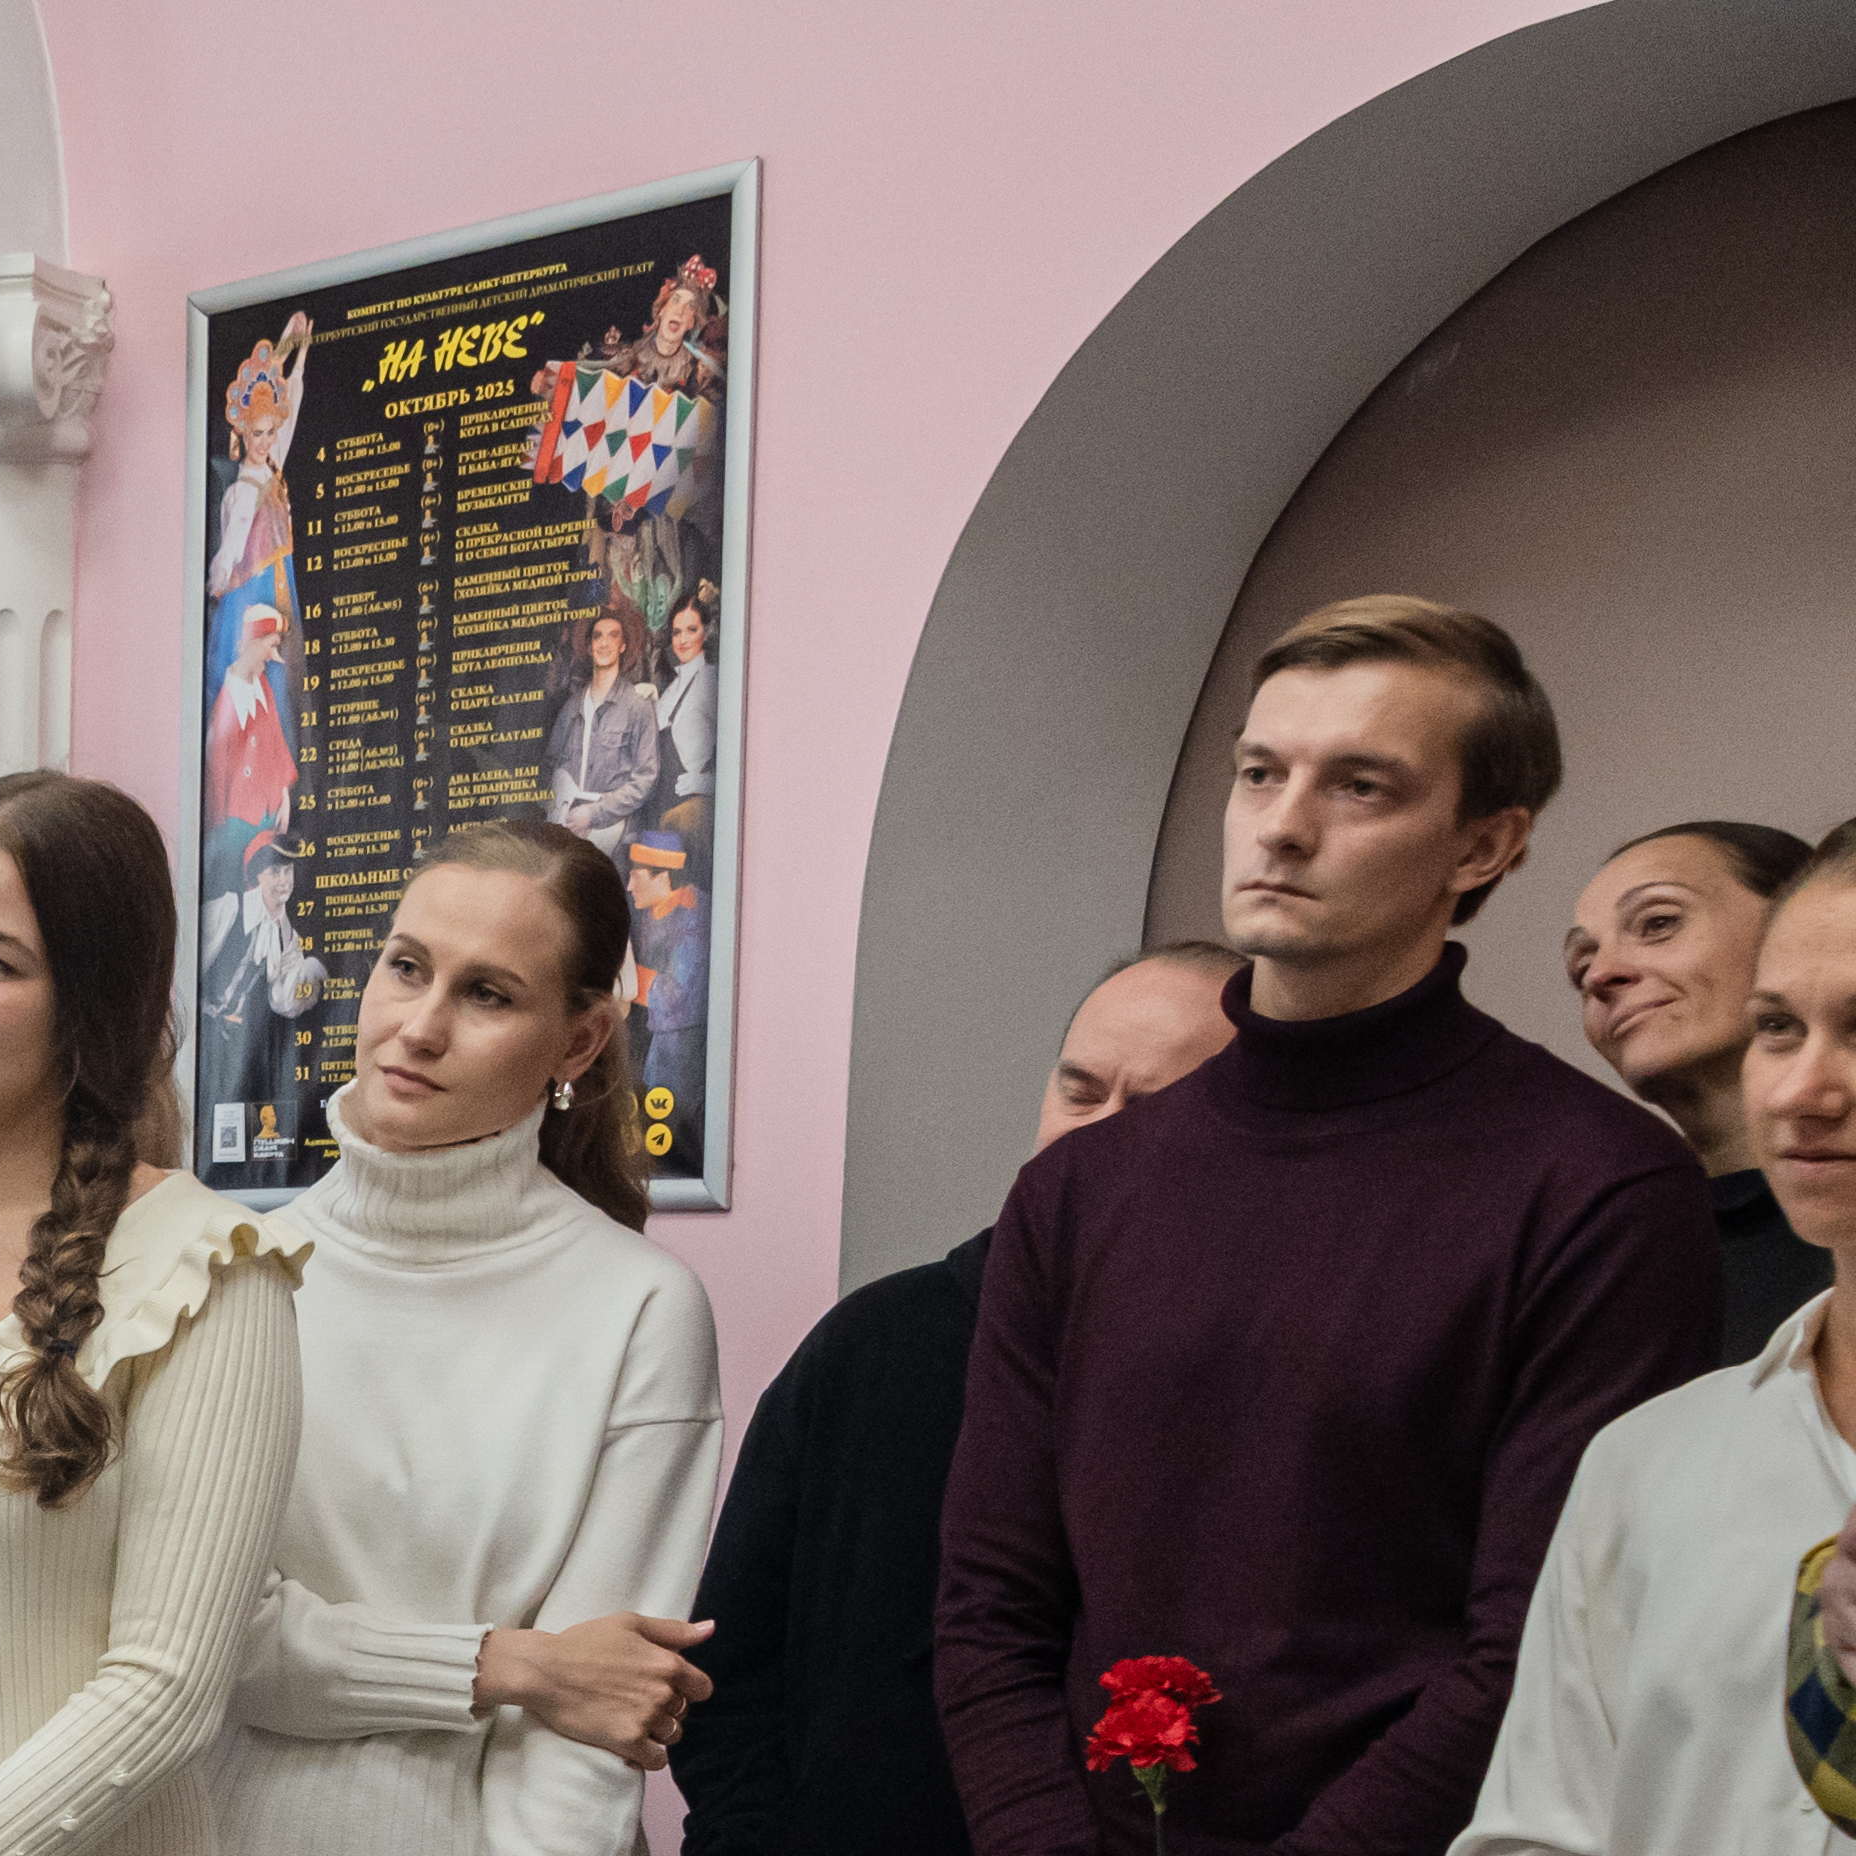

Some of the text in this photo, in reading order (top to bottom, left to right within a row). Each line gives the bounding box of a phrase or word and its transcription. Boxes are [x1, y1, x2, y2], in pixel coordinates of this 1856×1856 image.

[347, 261, 567, 320] КОМИТЕТ ПО КУЛЬТУРЕ САНКТ-ПЕТЕРБУРГА
[480, 287, 527, 308] ДЕТСКИЙ
[529, 267, 620, 297] ДРАМАТИЧЕСКИЙ
[621, 259, 654, 277] ТЕАТР
[384, 378, 515, 420] ОКТЯБРЬ 2025
[459, 399, 548, 426] ПРИКЛЮЧЕНИЯ
[459, 410, 553, 439] КОТА В САПОГАХ
[336, 431, 384, 450] СУББОТА
[316, 446, 325, 462] 4
[458, 439, 535, 464] ГУСИ-ЛЕБЕДИ
[335, 462, 410, 486] ВОСКРЕСЕНЬЕ
[458, 454, 521, 476] И БАБА-ЯГА
[315, 482, 324, 497] 5
[457, 477, 532, 501] БРЕМЕНСКИЕ
[457, 490, 529, 513] МУЗЫКАНТЫ
[334, 504, 381, 523] СУББОТА
[307, 519, 322, 536] 11
[455, 520, 499, 538] СКАЗКА
[455, 517, 597, 550] О ПРЕКРАСНОЙ ЦАРЕВНЕ
[333, 536, 408, 559] ВОСКРЕСЕНЬЕ
[455, 533, 579, 563] И О СЕМИ БОГАТЫРЯХ
[306, 555, 322, 572] 12
[454, 559, 569, 588] КАМЕННЫЙ ЦВЕТОК
[454, 567, 602, 601] (ХОЗЯЙКА МЕДНОЙ ГОРЫ)
[305, 602, 321, 619] 16
[453, 597, 568, 625] КАМЕННЫЙ ЦВЕТОК
[453, 605, 601, 638] (ХОЗЯЙКА МЕДНОЙ ГОРЫ)
[331, 626, 378, 643] СУББОТА
[304, 639, 320, 655] 18
[452, 639, 540, 662] ПРИКЛЮЧЕНИЯ
[330, 658, 405, 679] ВОСКРЕСЕНЬЕ
[451, 650, 552, 674] КОТА ЛЕОПОЛЬДА
[303, 675, 319, 691] 19
[451, 683, 494, 699] СКАЗКА
[329, 698, 379, 715] ВТОРНИК
[450, 689, 544, 711] О ЦАРЕ САЛТАНЕ
[300, 710, 317, 727] 21
[449, 720, 493, 736] СКАЗКА
[328, 737, 361, 751] СРЕДА
[449, 727, 542, 748] О ЦАРЕ САЛТАНЕ
[300, 745, 317, 763] 22
[448, 773, 470, 786] ДВА
[514, 765, 539, 778] ИЛИ
[327, 784, 374, 798] СУББОТА
[448, 778, 536, 797] КАК ИВАНУШКА
[298, 793, 316, 811] 25
[447, 788, 555, 810] БАБУ-ЯГУ ПОБЕДИЛ
[326, 828, 400, 846] ВОСКРЕСЕНЬЕ
[298, 837, 315, 857] 26
[315, 868, 400, 889] ШКОЛЬНЫЕ
[297, 901, 314, 917] 27
[324, 928, 373, 941] ВТОРНИК
[323, 977, 355, 989] СРЕДА
[294, 1030, 311, 1046] 30
[294, 1065, 309, 1080] 31
